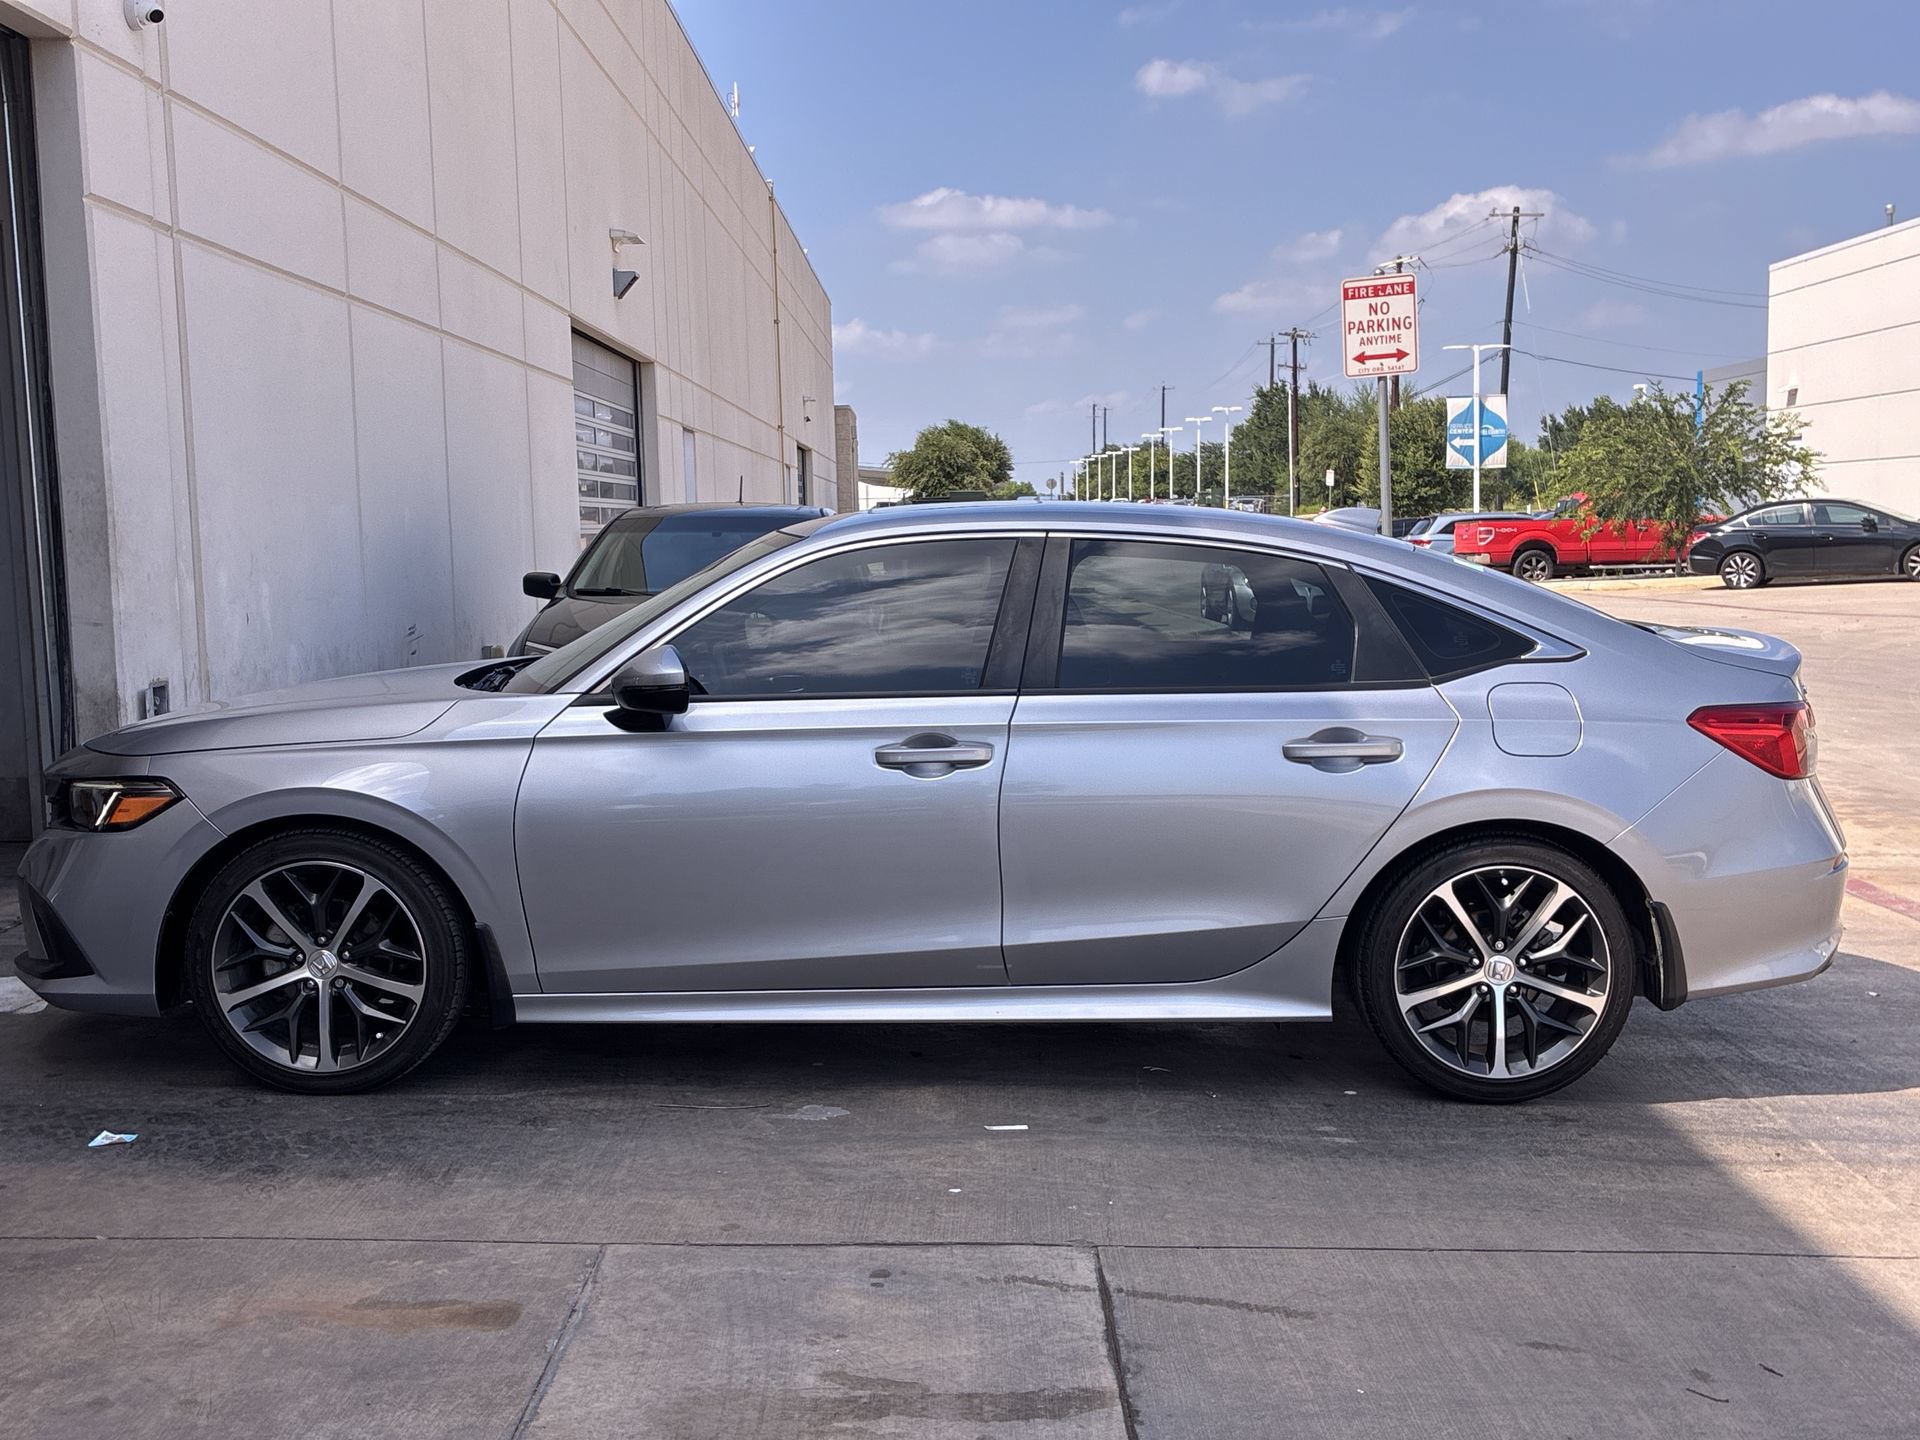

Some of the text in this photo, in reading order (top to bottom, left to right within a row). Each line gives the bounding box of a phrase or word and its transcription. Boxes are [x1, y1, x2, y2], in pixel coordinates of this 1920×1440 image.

[1348, 283, 1410, 298] FIRE LANE
[1369, 301, 1390, 316] NO
[1348, 316, 1412, 335] PARKING
[1359, 333, 1402, 347] ANYTIME
